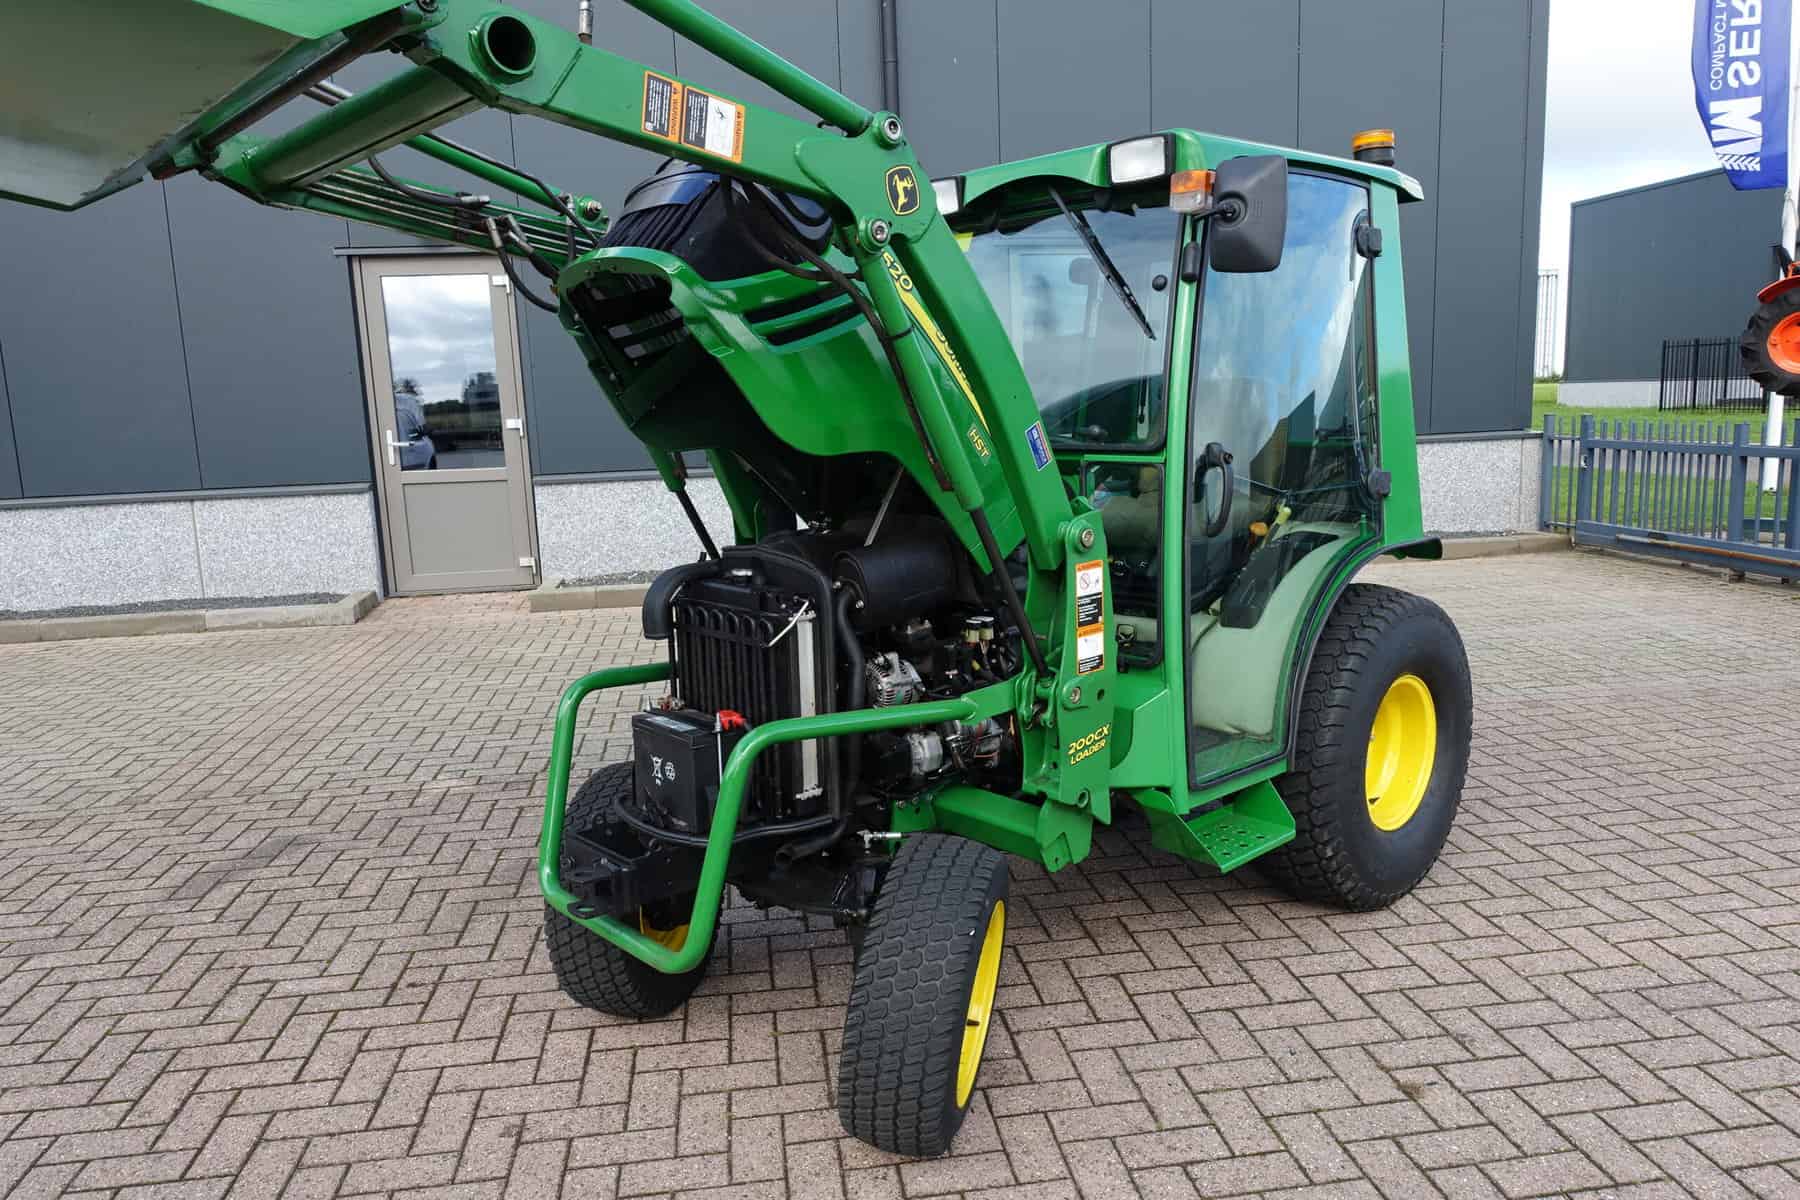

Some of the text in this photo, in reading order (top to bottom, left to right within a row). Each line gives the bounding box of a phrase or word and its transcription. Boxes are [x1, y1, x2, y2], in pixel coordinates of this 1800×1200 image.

[969, 429, 990, 457] HST
[1068, 724, 1110, 754] 200CX
[1071, 739, 1106, 765] LOADER
